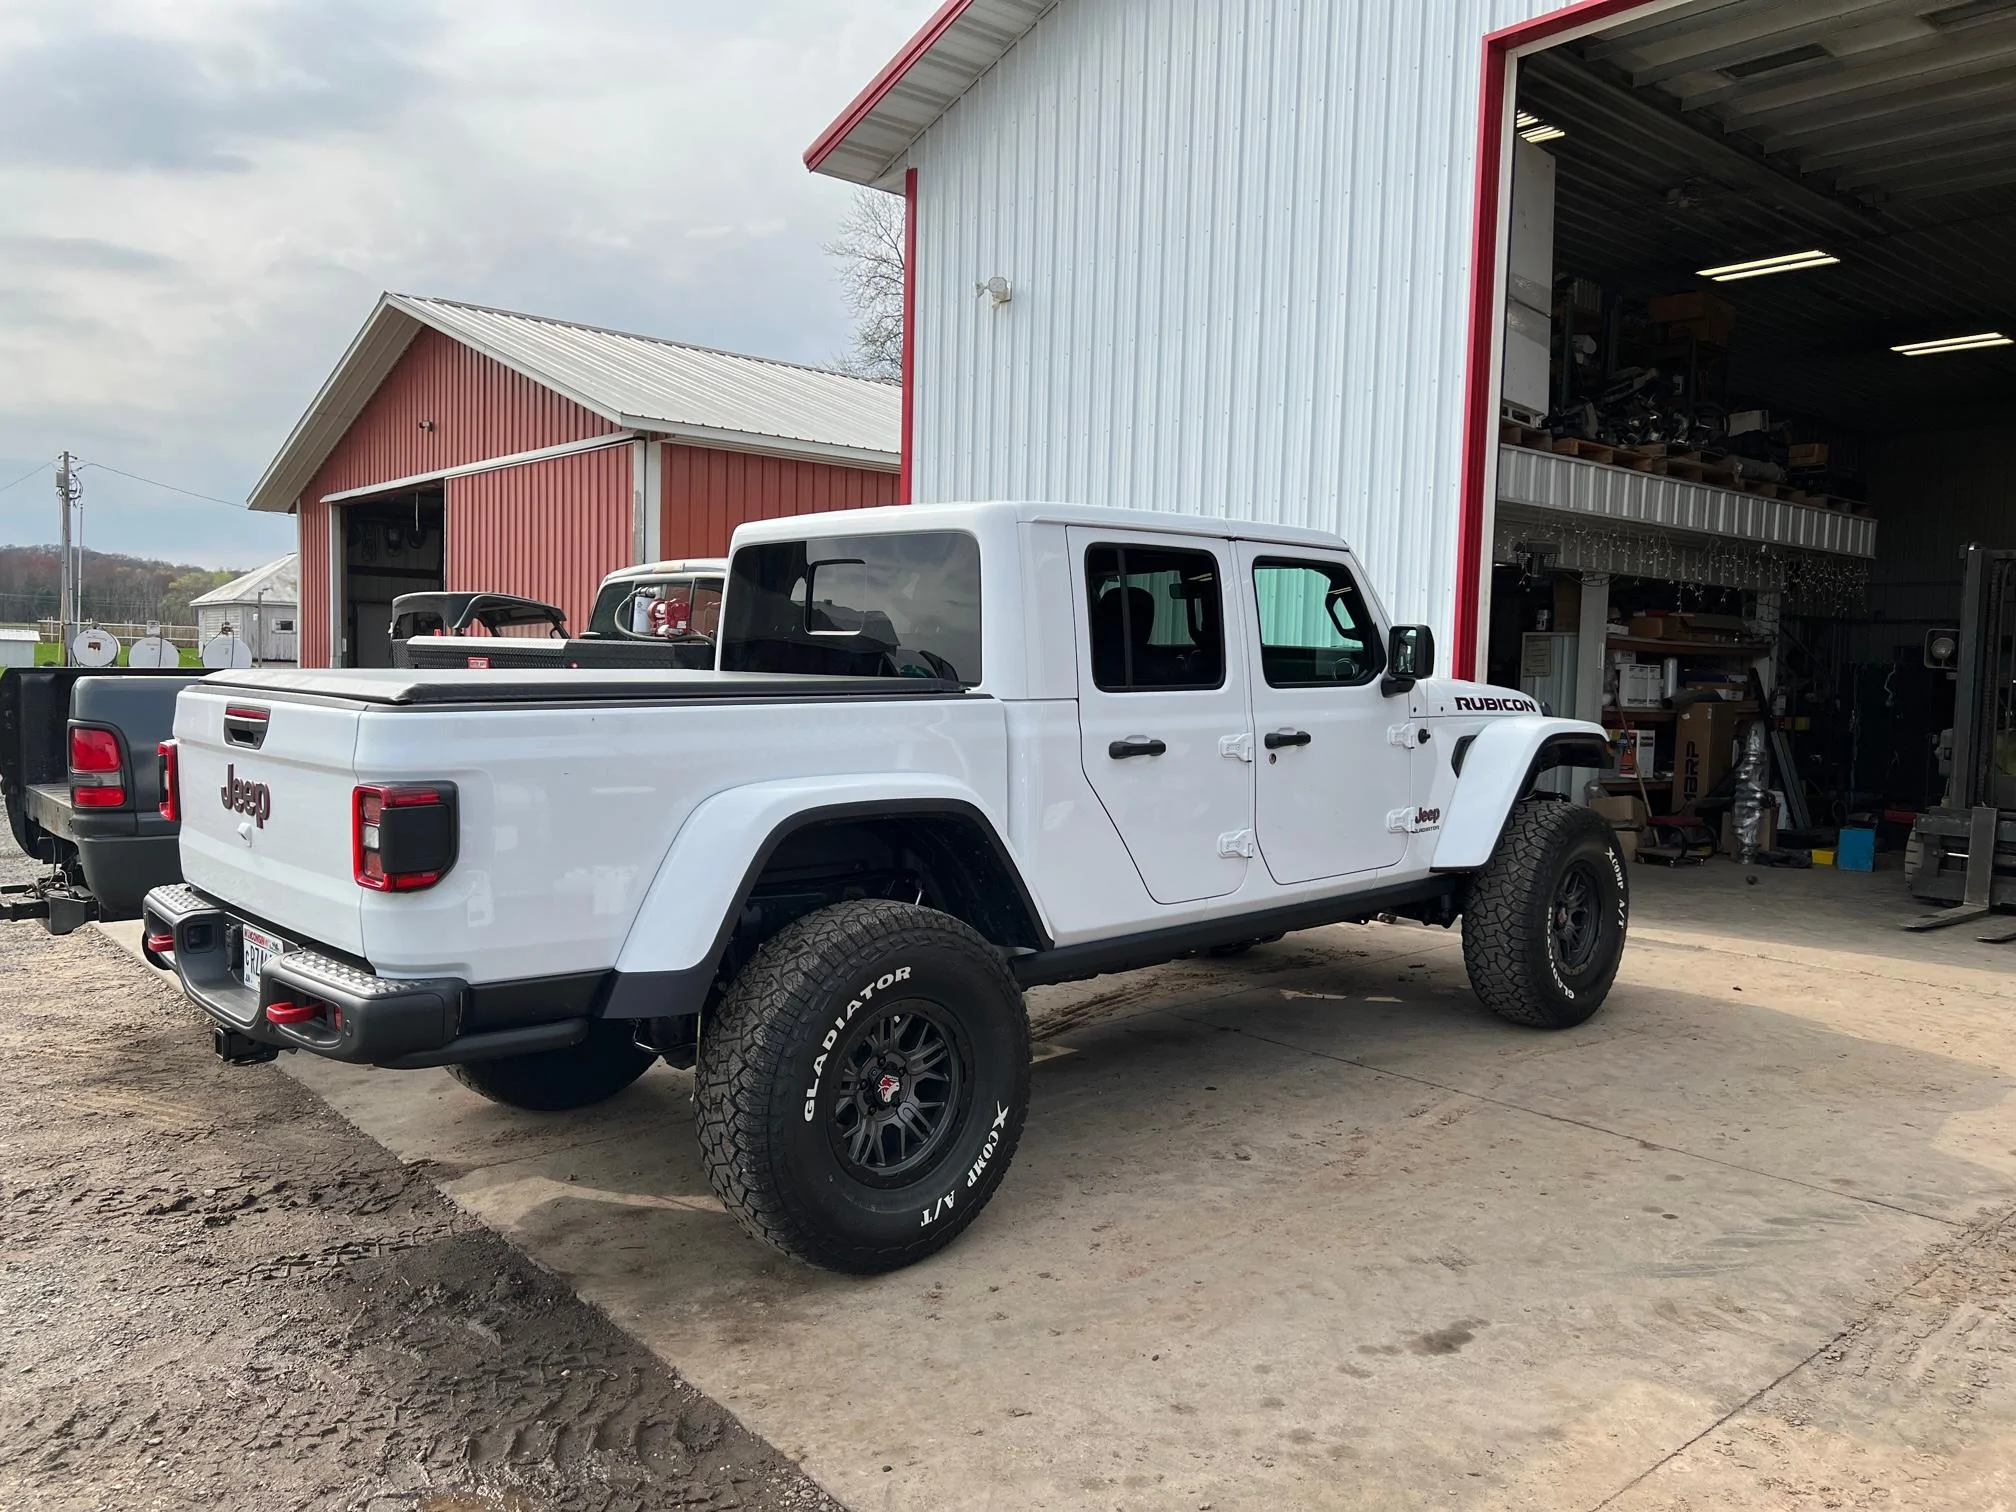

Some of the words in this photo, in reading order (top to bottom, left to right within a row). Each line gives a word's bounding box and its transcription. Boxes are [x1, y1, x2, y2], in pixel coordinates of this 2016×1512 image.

[1454, 697, 1537, 712] RUBICON
[220, 763, 271, 829] Jeep
[1413, 825, 1440, 833] LADIATOR
[1415, 807, 1440, 823] Jeep
[1618, 898, 1626, 929] A/T
[804, 966, 912, 1122] GLADIATOR
[920, 1190, 955, 1227] A/T
